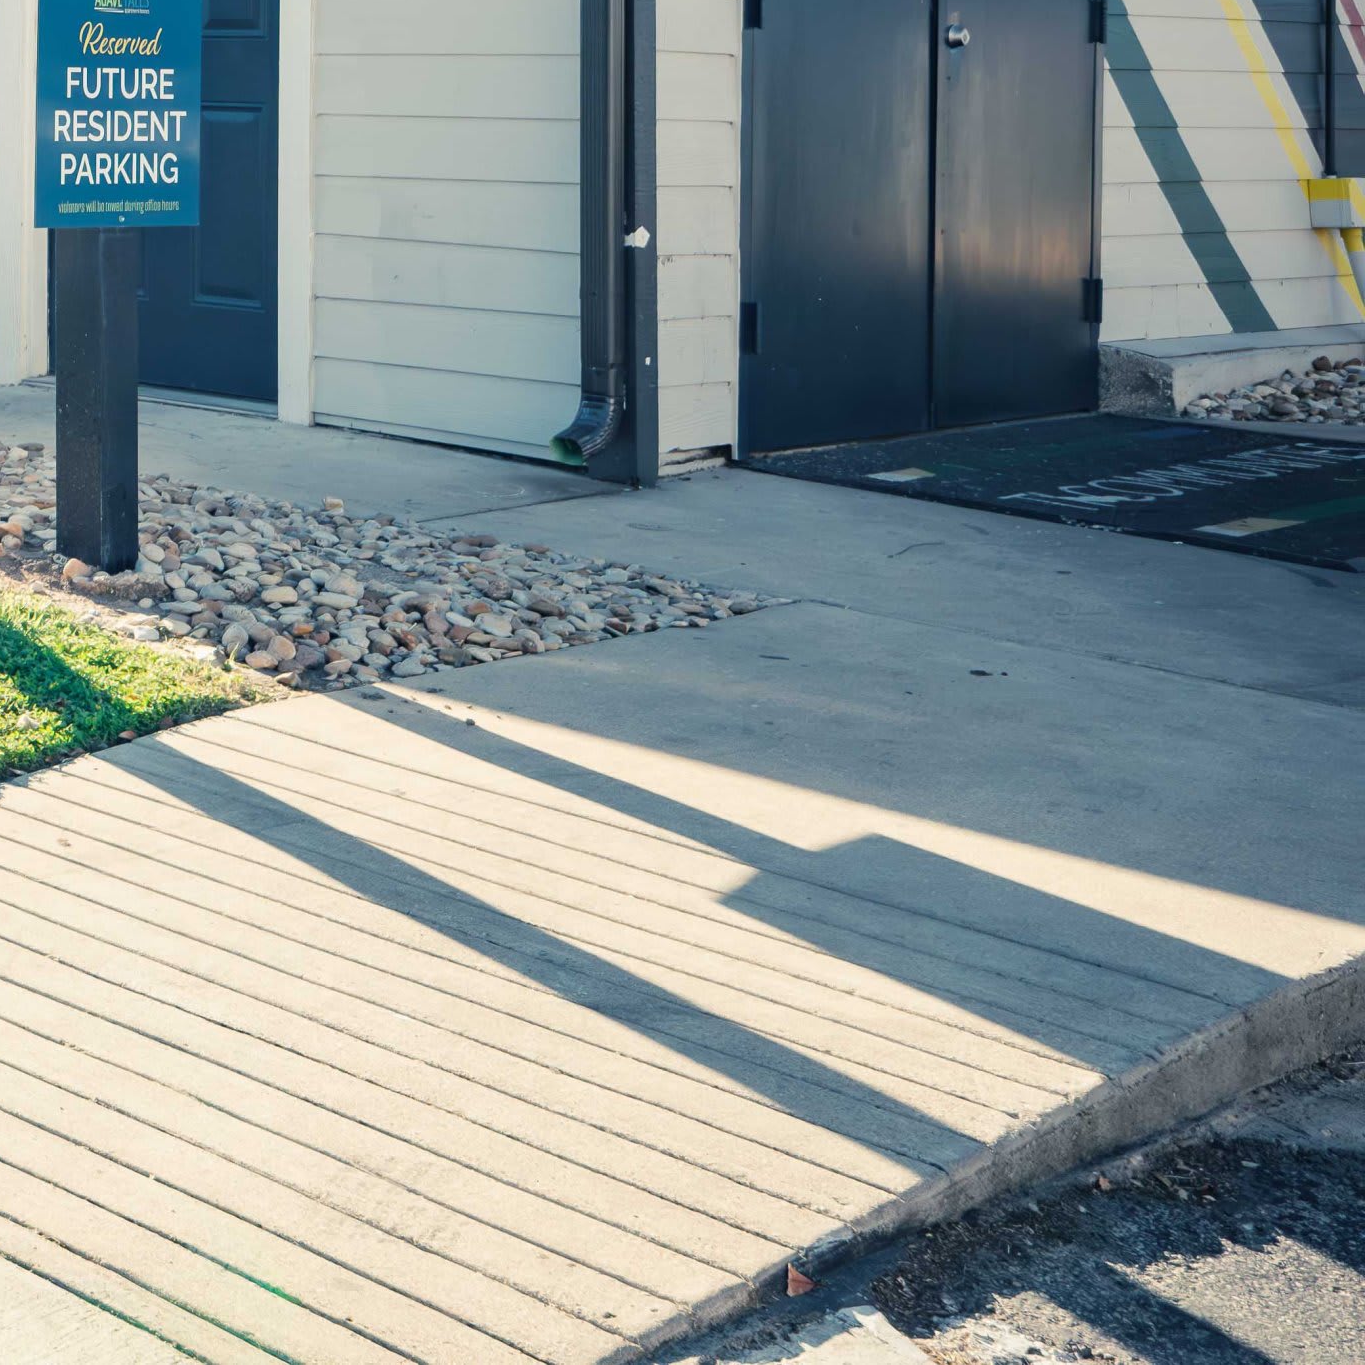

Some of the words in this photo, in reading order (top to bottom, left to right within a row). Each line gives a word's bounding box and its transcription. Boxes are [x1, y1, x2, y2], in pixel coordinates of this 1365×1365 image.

[79, 21, 163, 56] Reserved
[66, 66, 175, 100] FUTURE
[54, 109, 187, 142] RESIDENT
[60, 152, 180, 186] PARKING
